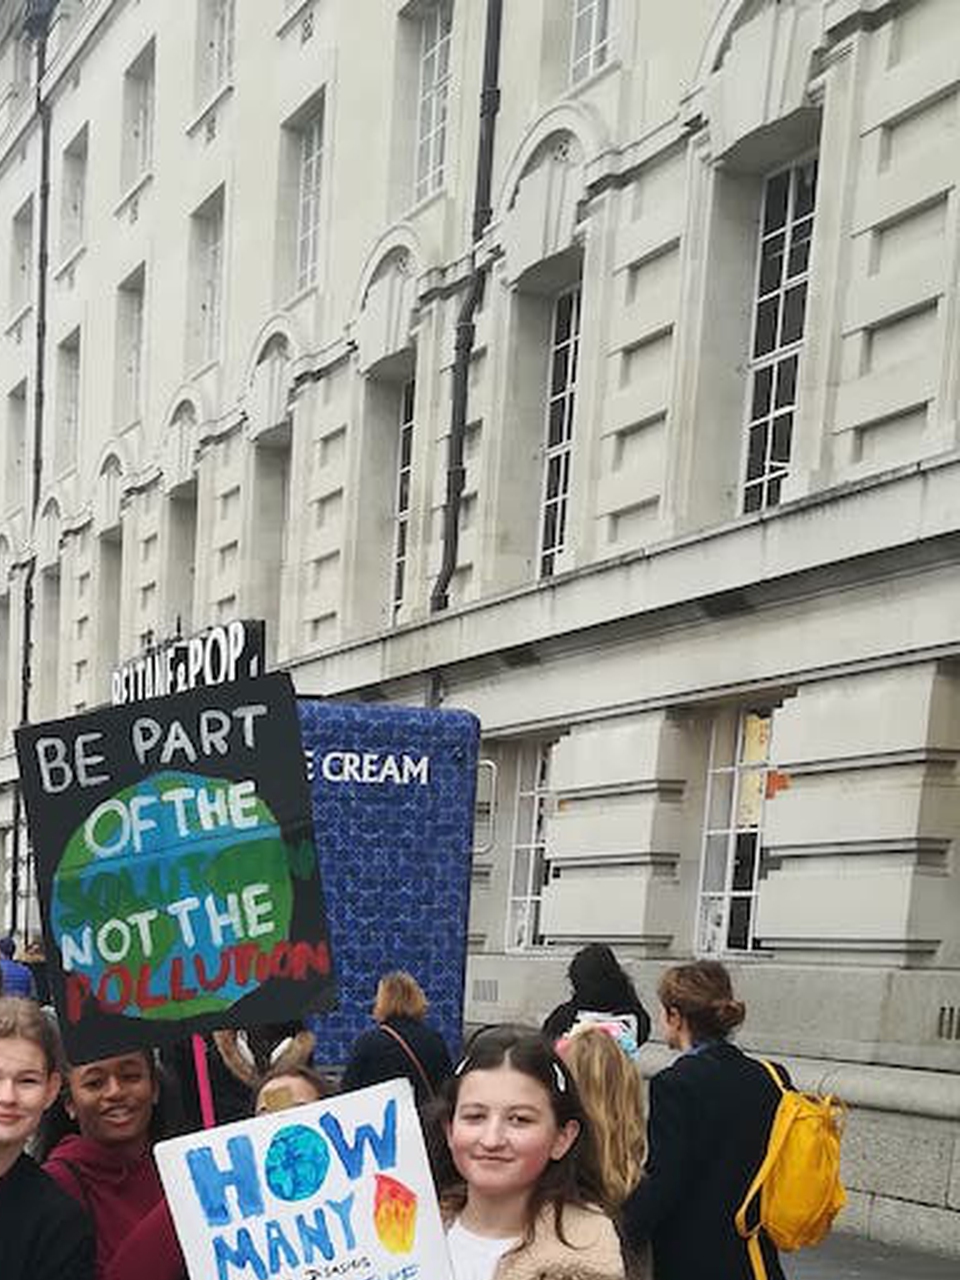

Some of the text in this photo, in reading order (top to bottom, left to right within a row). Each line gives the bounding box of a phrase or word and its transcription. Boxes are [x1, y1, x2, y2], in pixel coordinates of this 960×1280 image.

[36, 704, 268, 794] BE PART
[322, 751, 430, 785] CREAM
[84, 780, 258, 859] OF THE
[61, 908, 158, 972] NOT
[167, 882, 275, 948] THE
[65, 940, 331, 1024] POLLUTION
[185, 1098, 398, 1228] HOW
